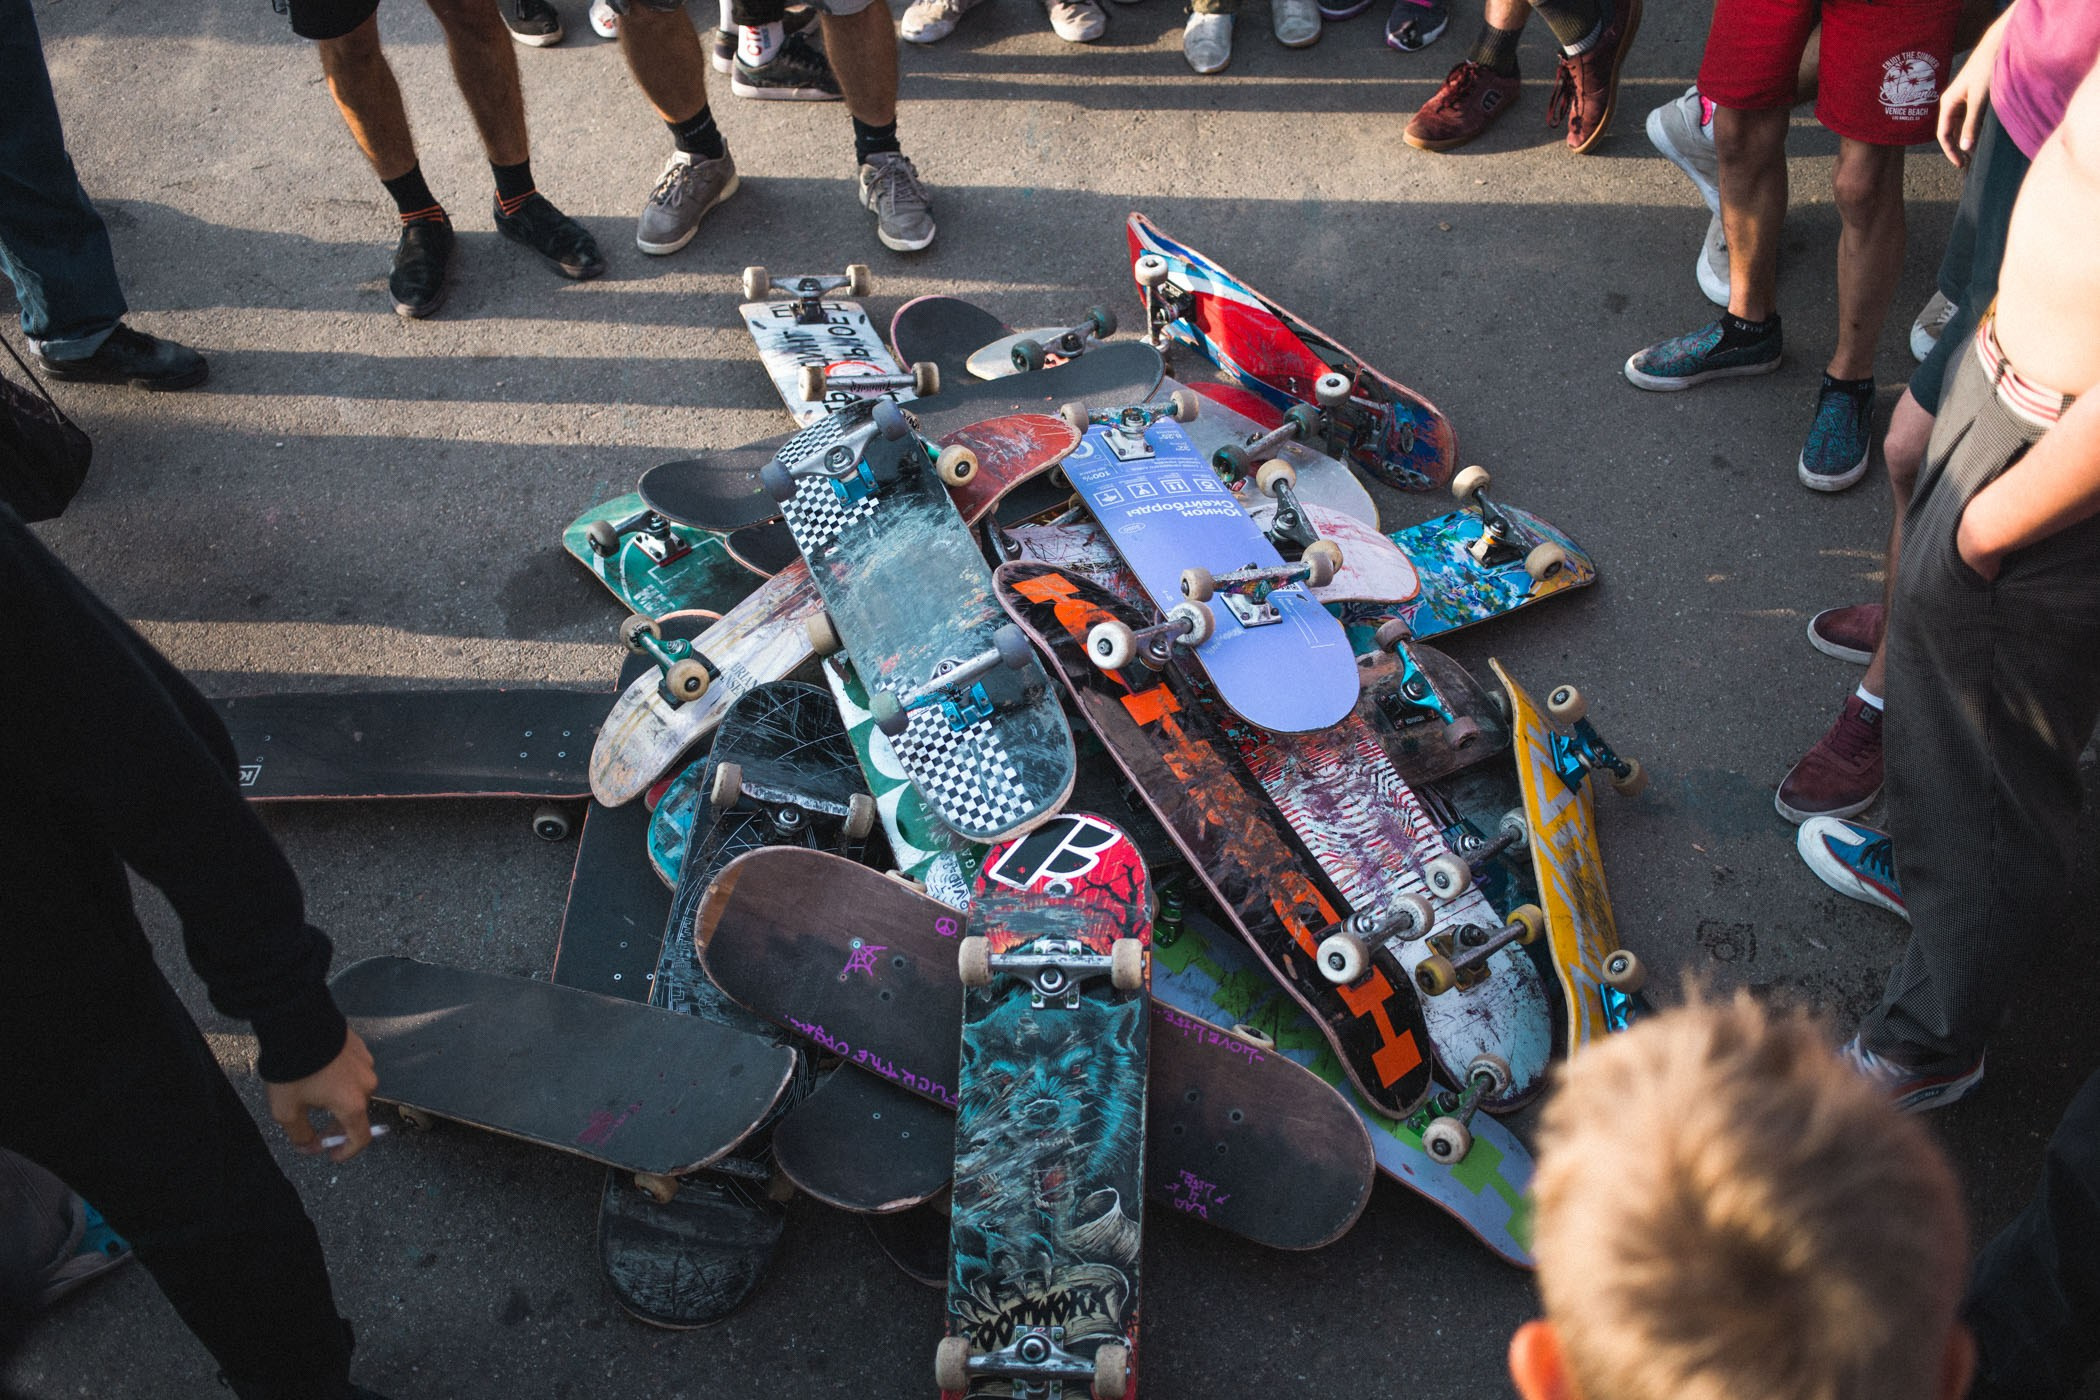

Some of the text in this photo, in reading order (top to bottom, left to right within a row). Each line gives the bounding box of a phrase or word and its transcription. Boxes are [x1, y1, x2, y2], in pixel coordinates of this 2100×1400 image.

[1882, 54, 1901, 70] ENJOY
[1902, 51, 1916, 60] THE
[1885, 107, 1929, 116] VENICE BEACH
[1082, 470, 1111, 481] 100%
[1126, 499, 1234, 518] Скейтборды
[1182, 506, 1242, 518] Юнион
[730, 662, 758, 689] BRIAN
